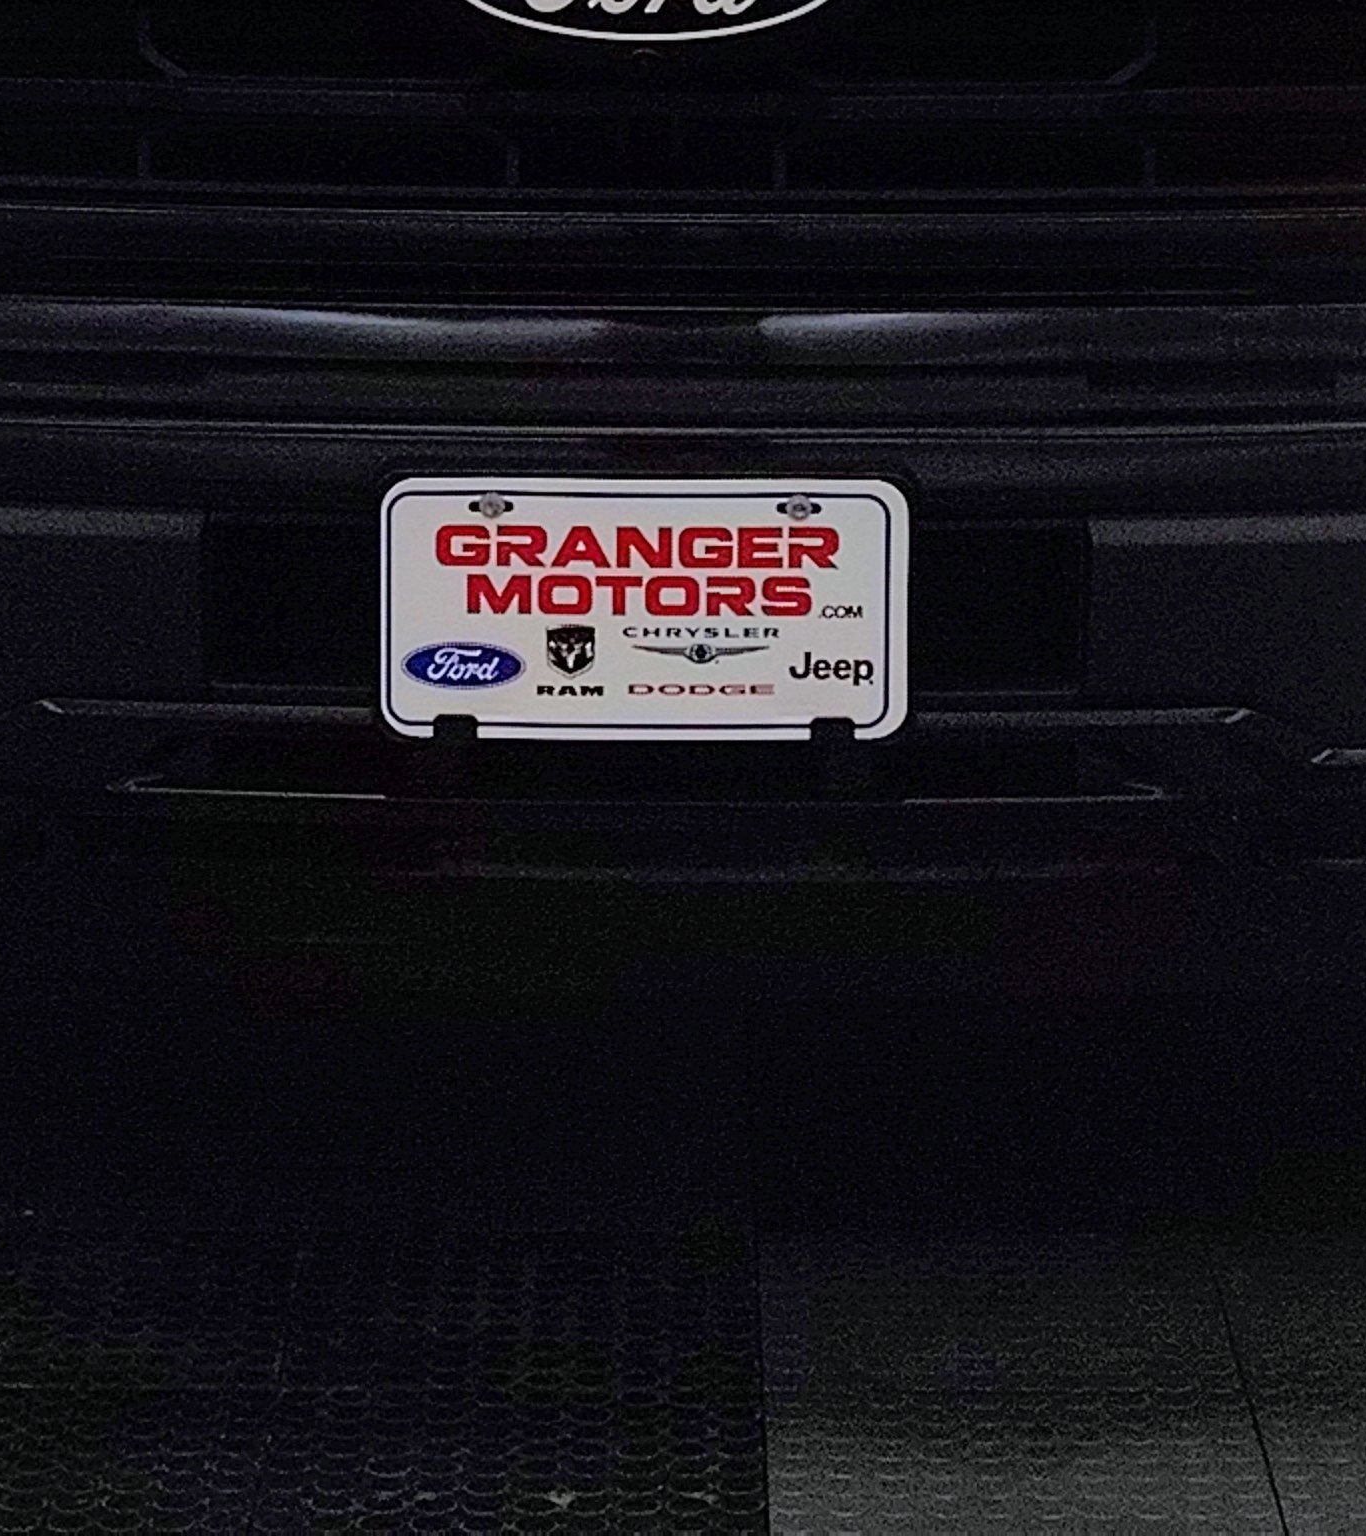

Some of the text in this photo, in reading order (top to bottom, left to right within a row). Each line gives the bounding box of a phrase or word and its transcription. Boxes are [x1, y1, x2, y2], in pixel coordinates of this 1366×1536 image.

[435, 525, 840, 569] GRANGER
[466, 574, 864, 619] MOTORS .COM
[622, 626, 781, 639] CHRYSLER
[427, 647, 499, 680] Ford
[788, 651, 874, 686] Jeep
[536, 685, 605, 697] RAM
[627, 683, 776, 696] DODGE
